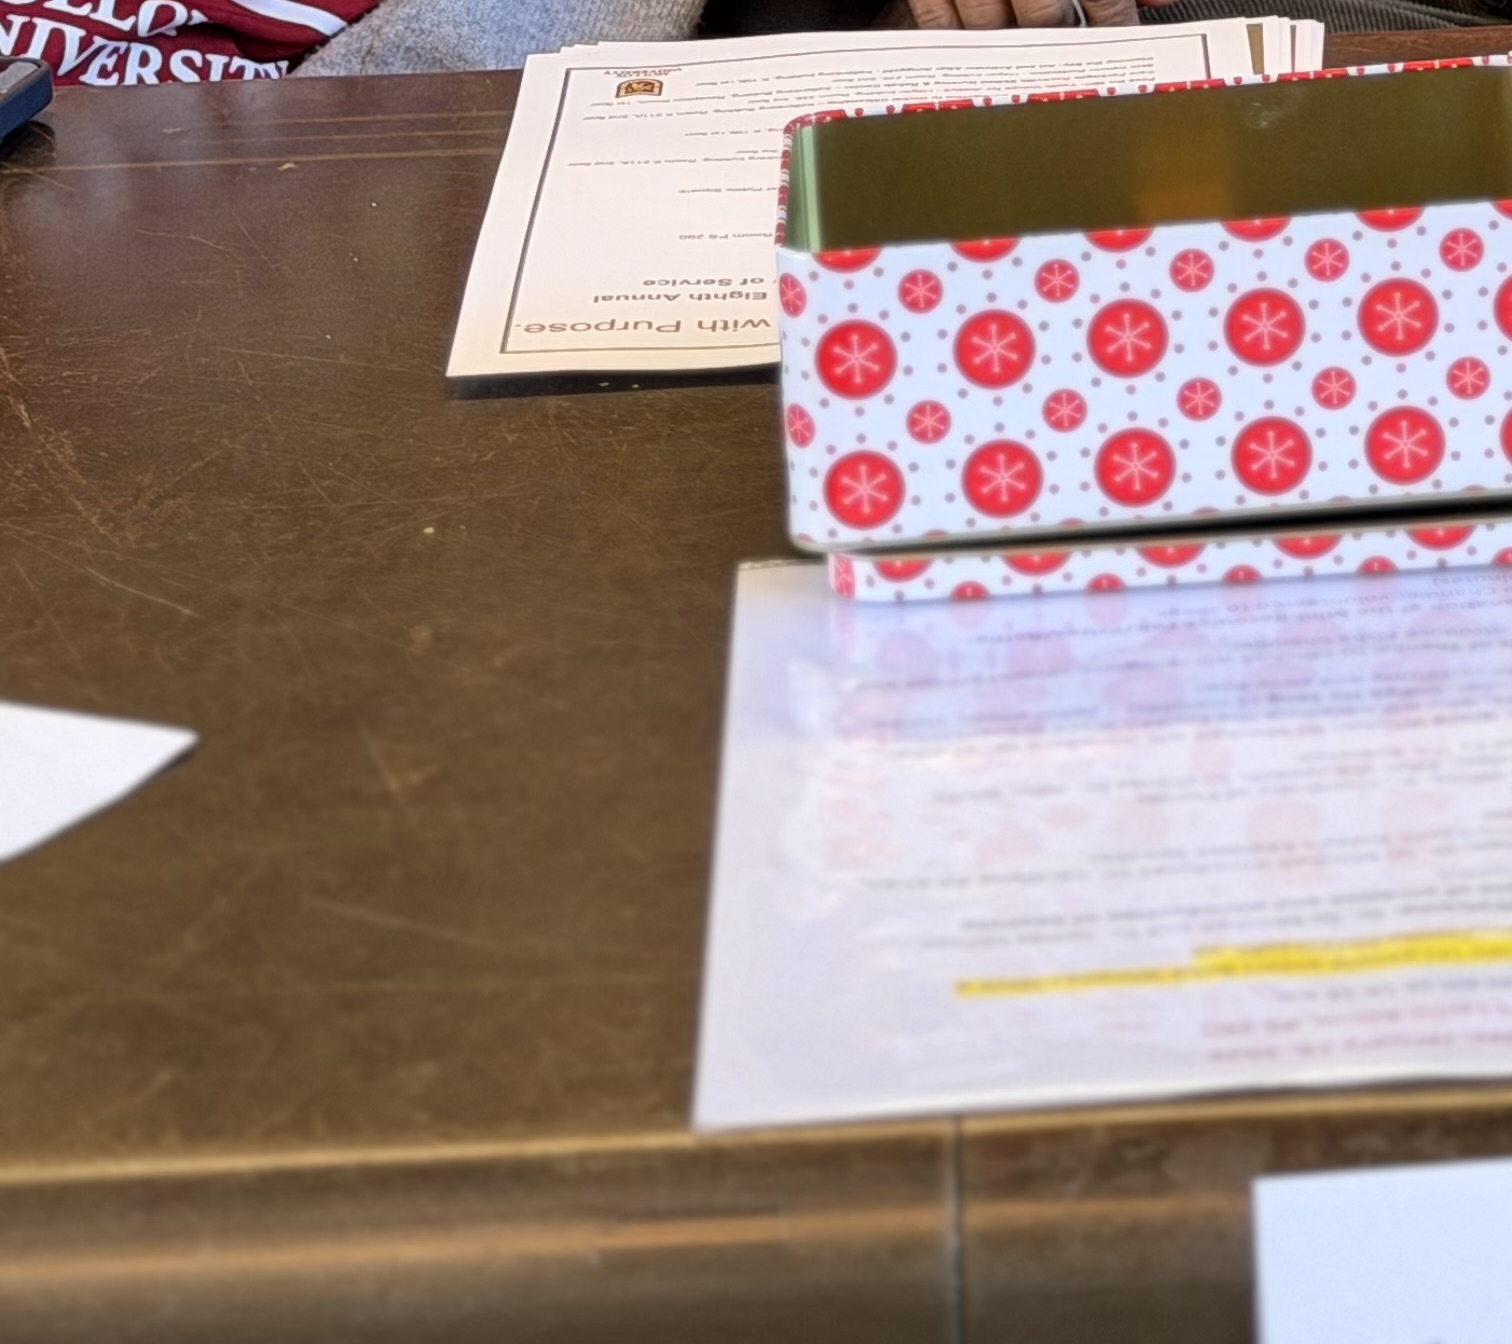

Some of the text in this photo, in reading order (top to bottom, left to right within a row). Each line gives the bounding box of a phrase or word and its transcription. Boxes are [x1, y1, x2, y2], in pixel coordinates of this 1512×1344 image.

[641, 277, 765, 288] of Service
[592, 290, 768, 303] Eighth Annual
[513, 317, 771, 335] with Purpose.
